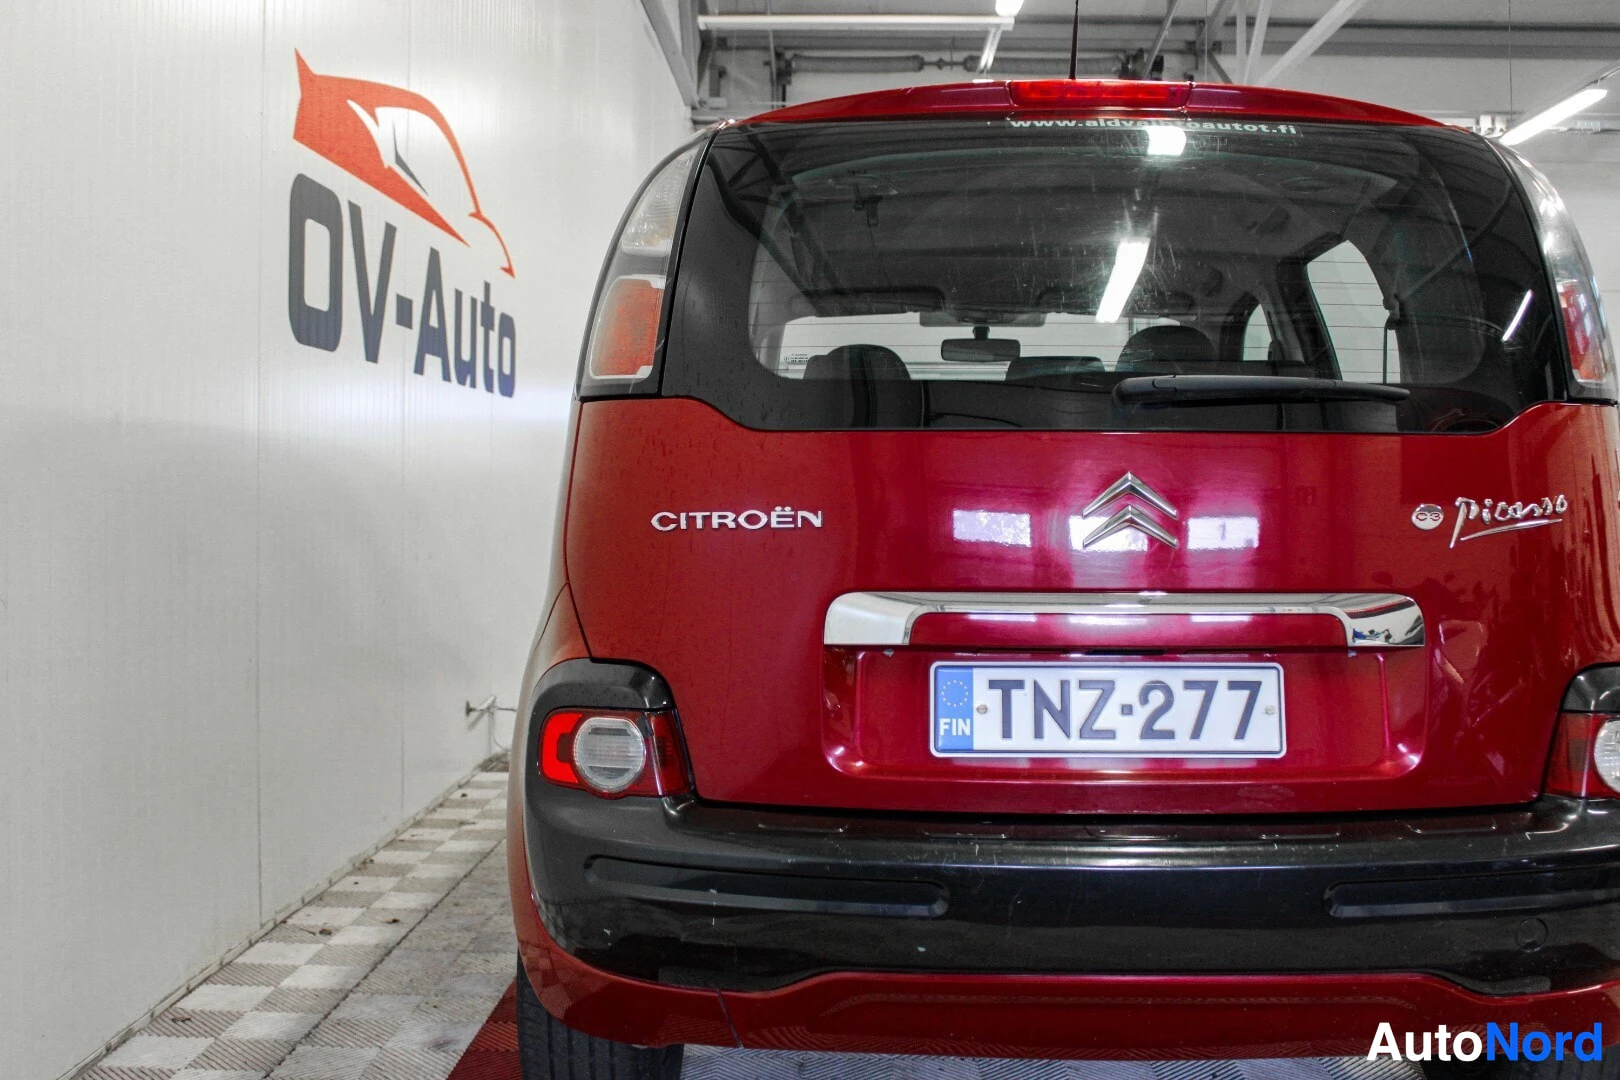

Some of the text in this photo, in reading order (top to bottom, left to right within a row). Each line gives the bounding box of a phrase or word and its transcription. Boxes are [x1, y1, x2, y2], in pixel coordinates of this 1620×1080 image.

[289, 173, 515, 398] OV-Auto
[650, 506, 823, 531] CITROËN
[1449, 494, 1569, 548] Picasso
[939, 718, 971, 737] FIN
[988, 679, 1263, 740] TNZ-277
